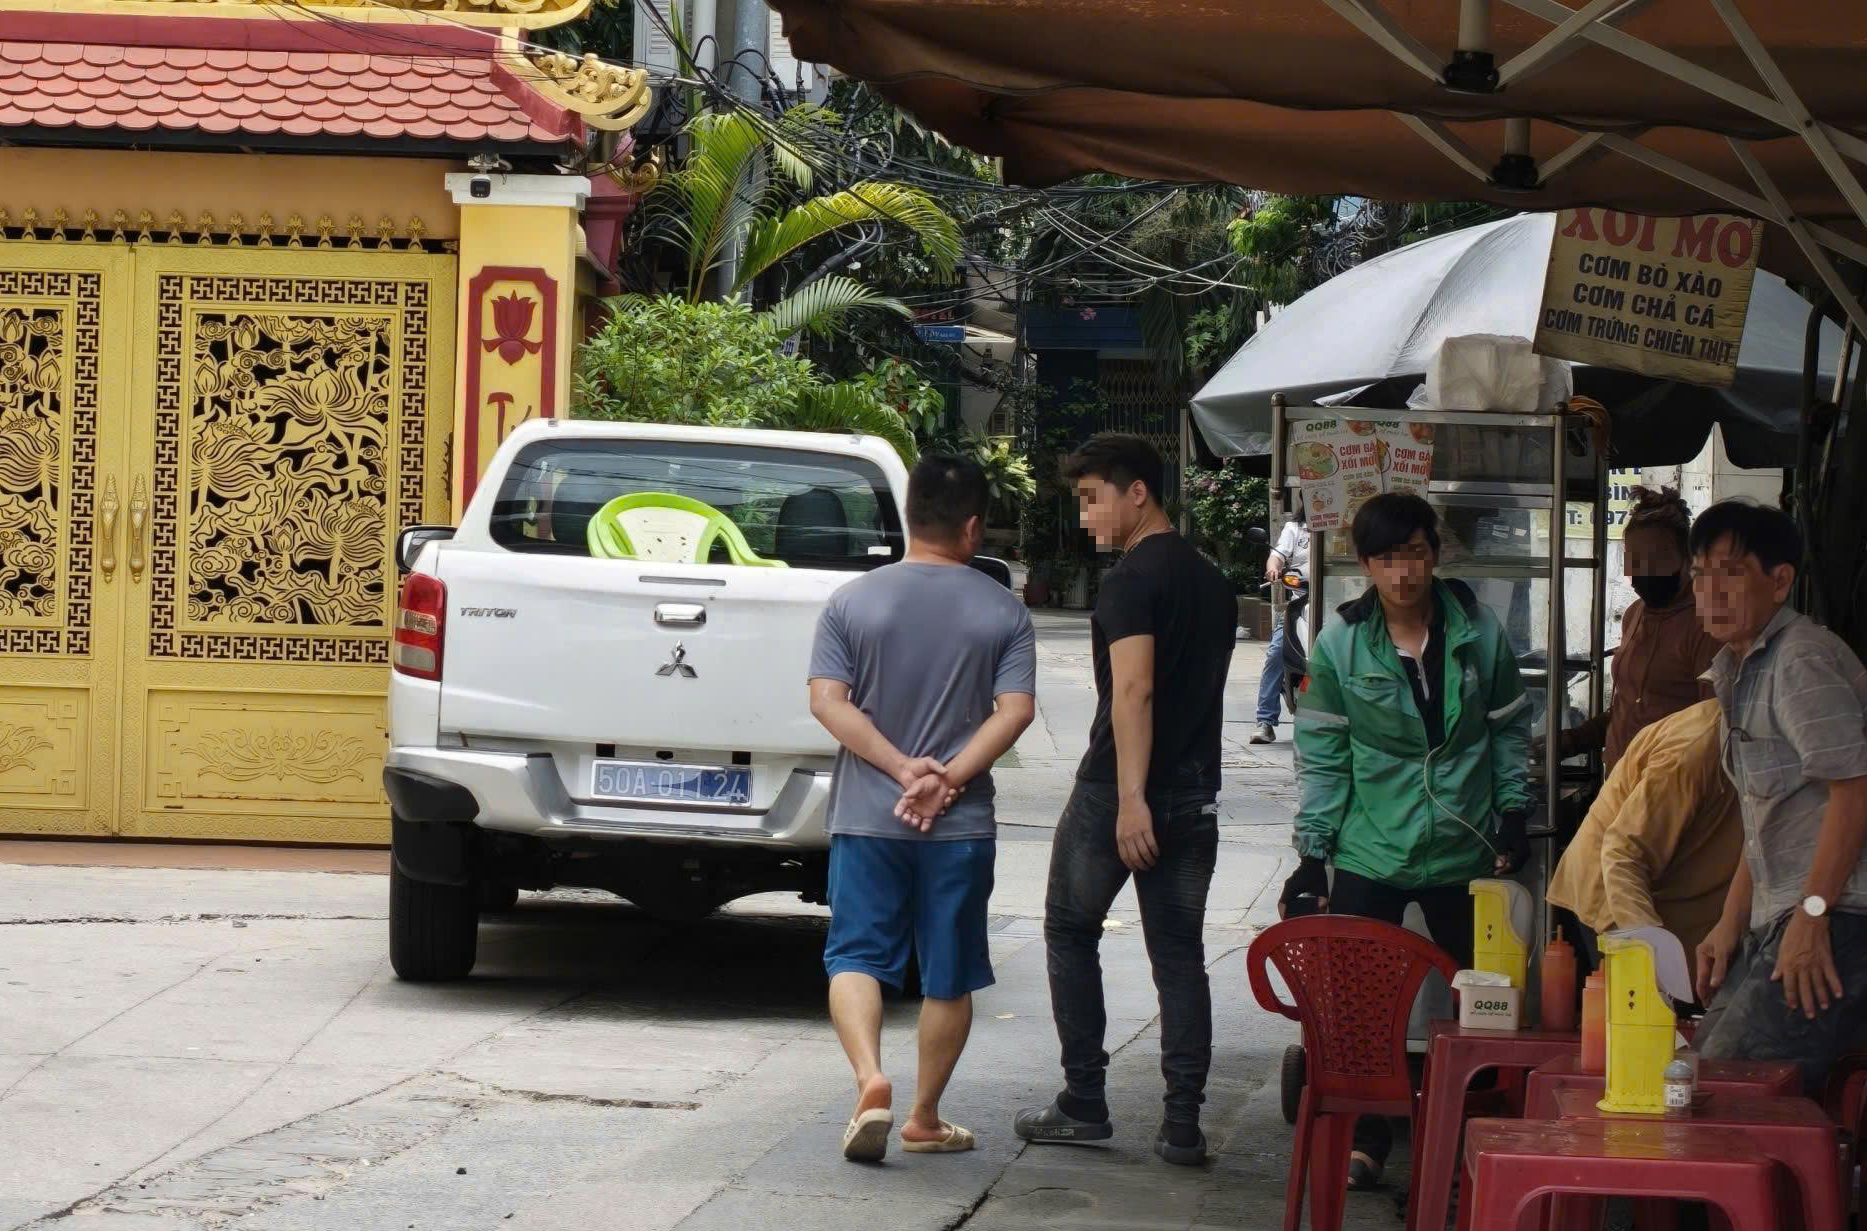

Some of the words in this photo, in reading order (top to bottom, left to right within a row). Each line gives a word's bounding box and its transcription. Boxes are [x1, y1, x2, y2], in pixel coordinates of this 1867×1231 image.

[1579, 253, 1631, 281] CƠM
[1636, 262, 1668, 288] BÒ
[1675, 270, 1722, 298] XÀO
[1573, 283, 1625, 310] CƠM
[1631, 293, 1676, 322] CHẢ
[1684, 303, 1715, 329] CÁ
[1545, 308, 1582, 334] CƠM
[1587, 315, 1639, 344] TRỨNG
[1643, 326, 1695, 355] CHIÊN
[1305, 419, 1337, 432] QQ88
[460, 607, 517, 618] TRITON
[1474, 1000, 1508, 1011] QQ88
